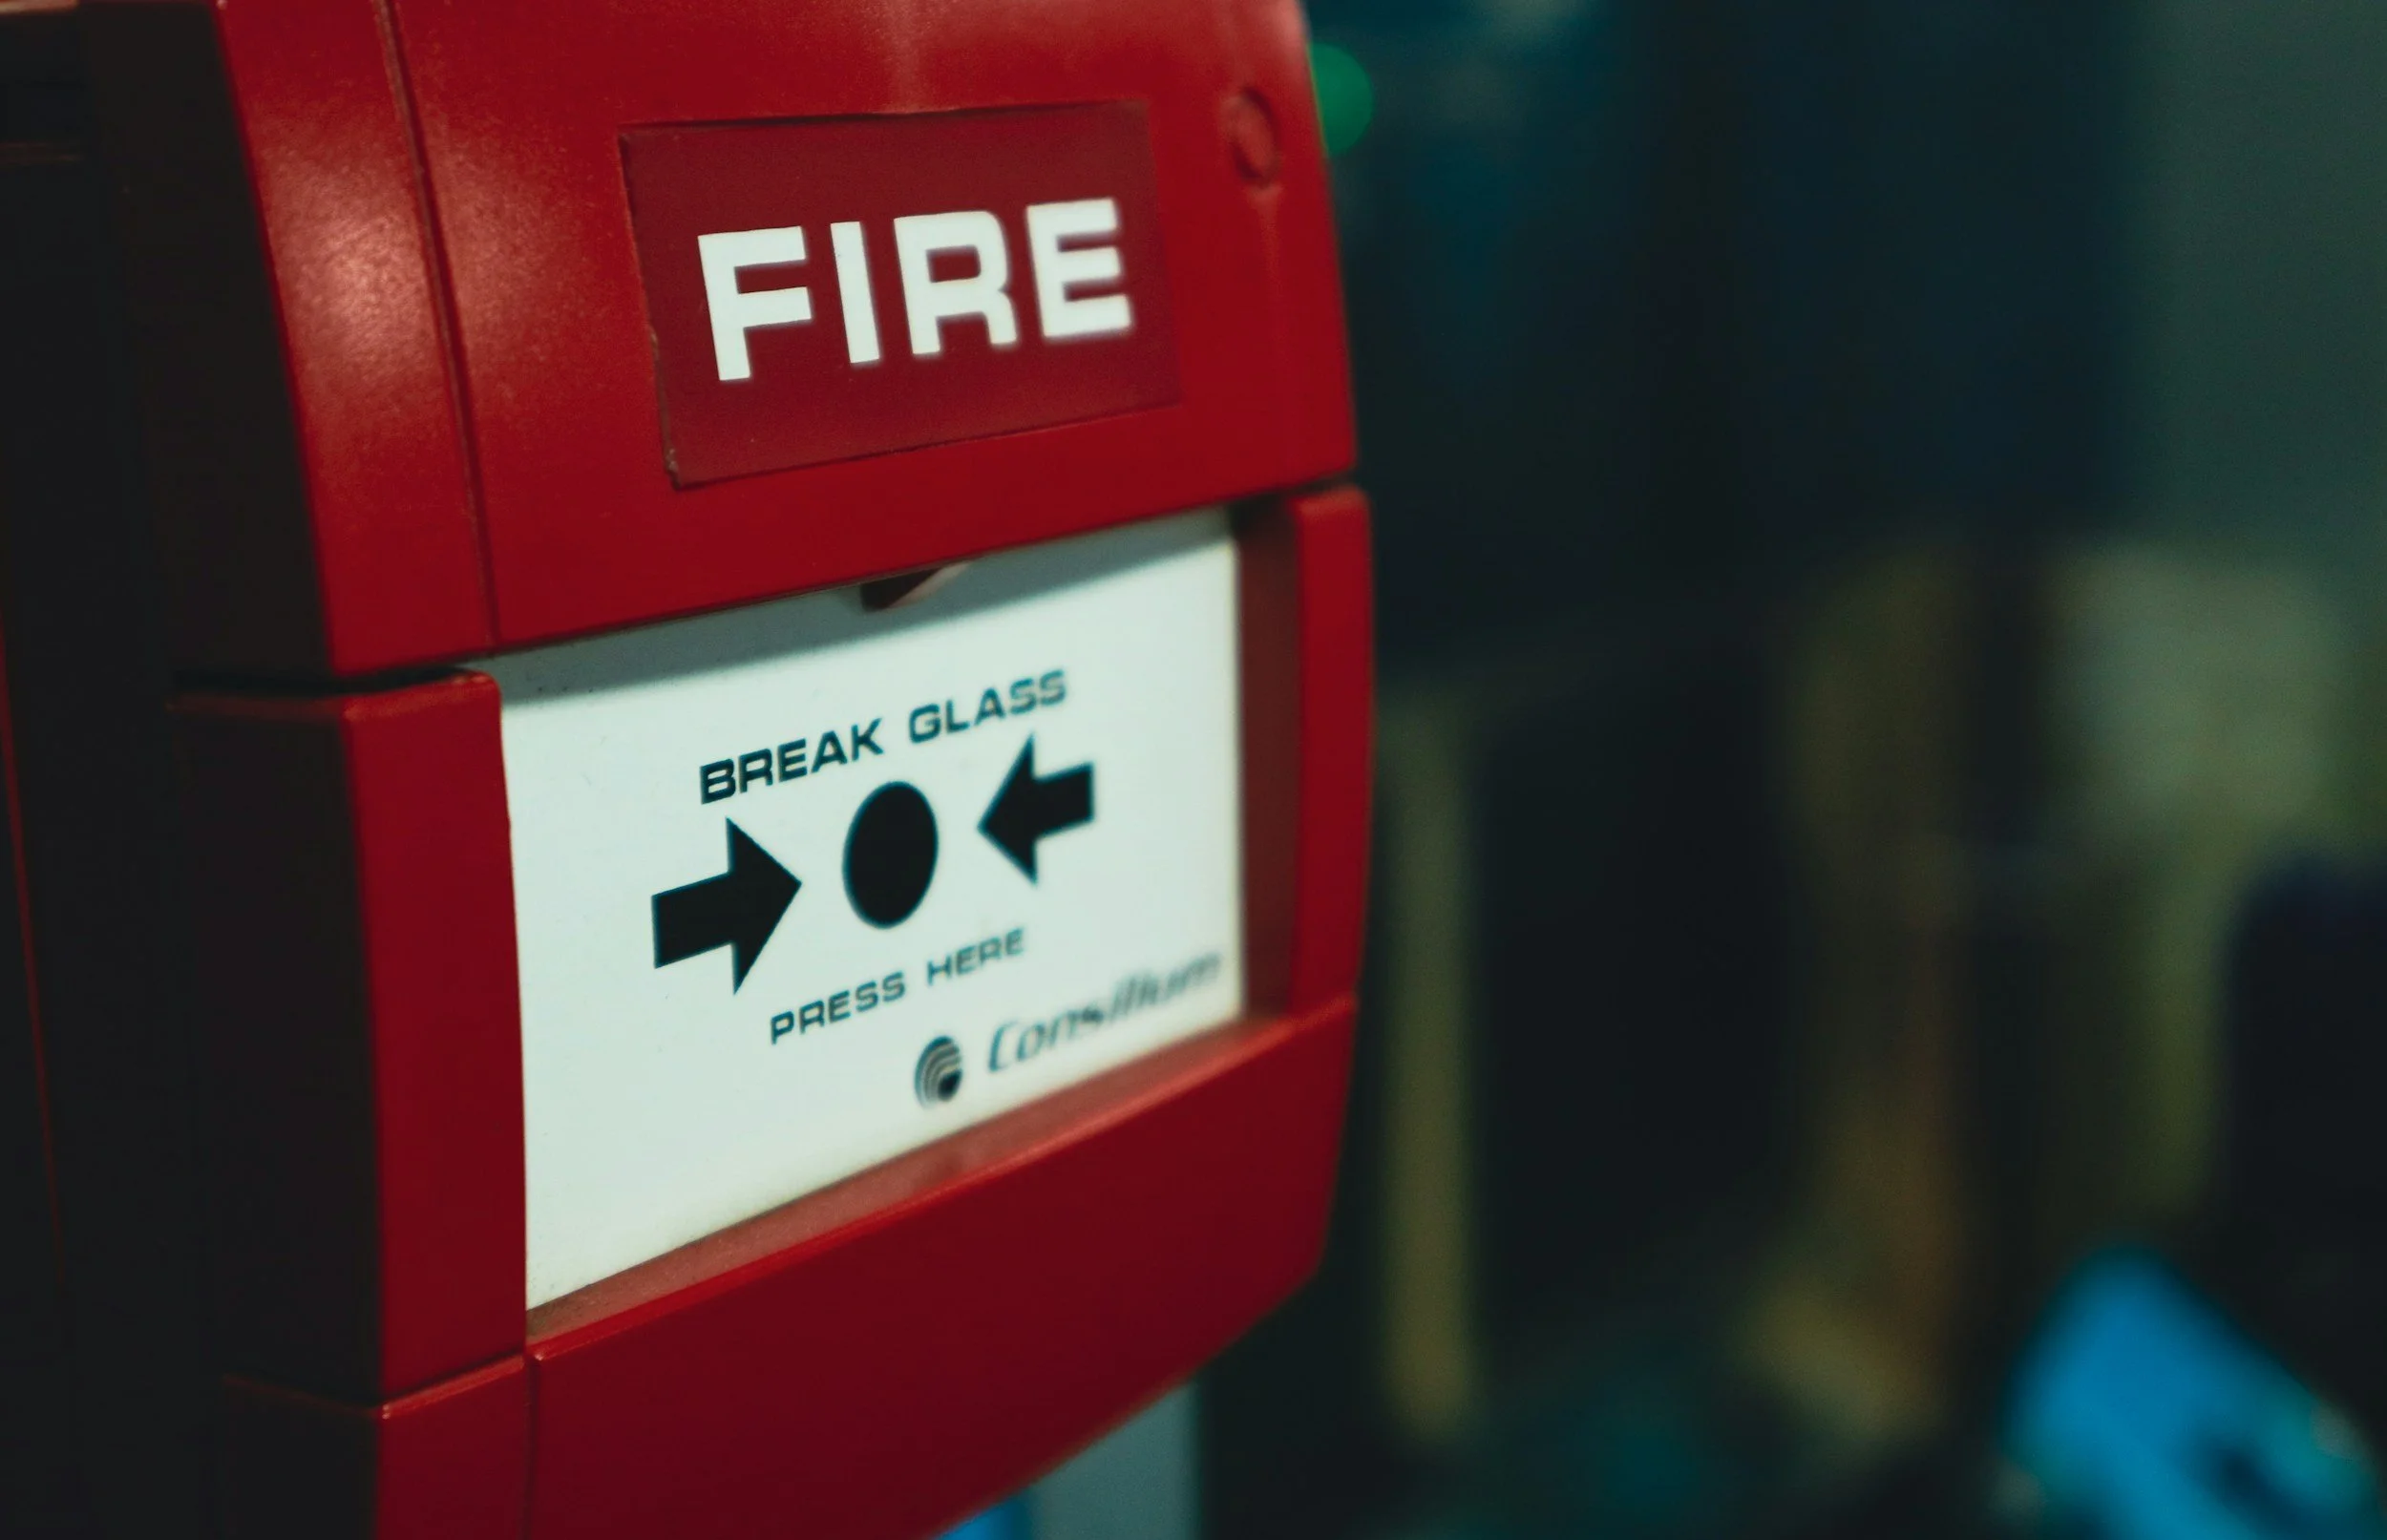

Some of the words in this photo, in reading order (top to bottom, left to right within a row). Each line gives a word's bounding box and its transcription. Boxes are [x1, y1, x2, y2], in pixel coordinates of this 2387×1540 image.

[698, 198, 1131, 381] FIRE
[700, 717, 883, 805] BREAK
[909, 669, 1067, 743] GLASS
[771, 972, 906, 1044] PRESS
[927, 928, 1025, 985] HERE
[988, 953, 1222, 1072] Consilium
